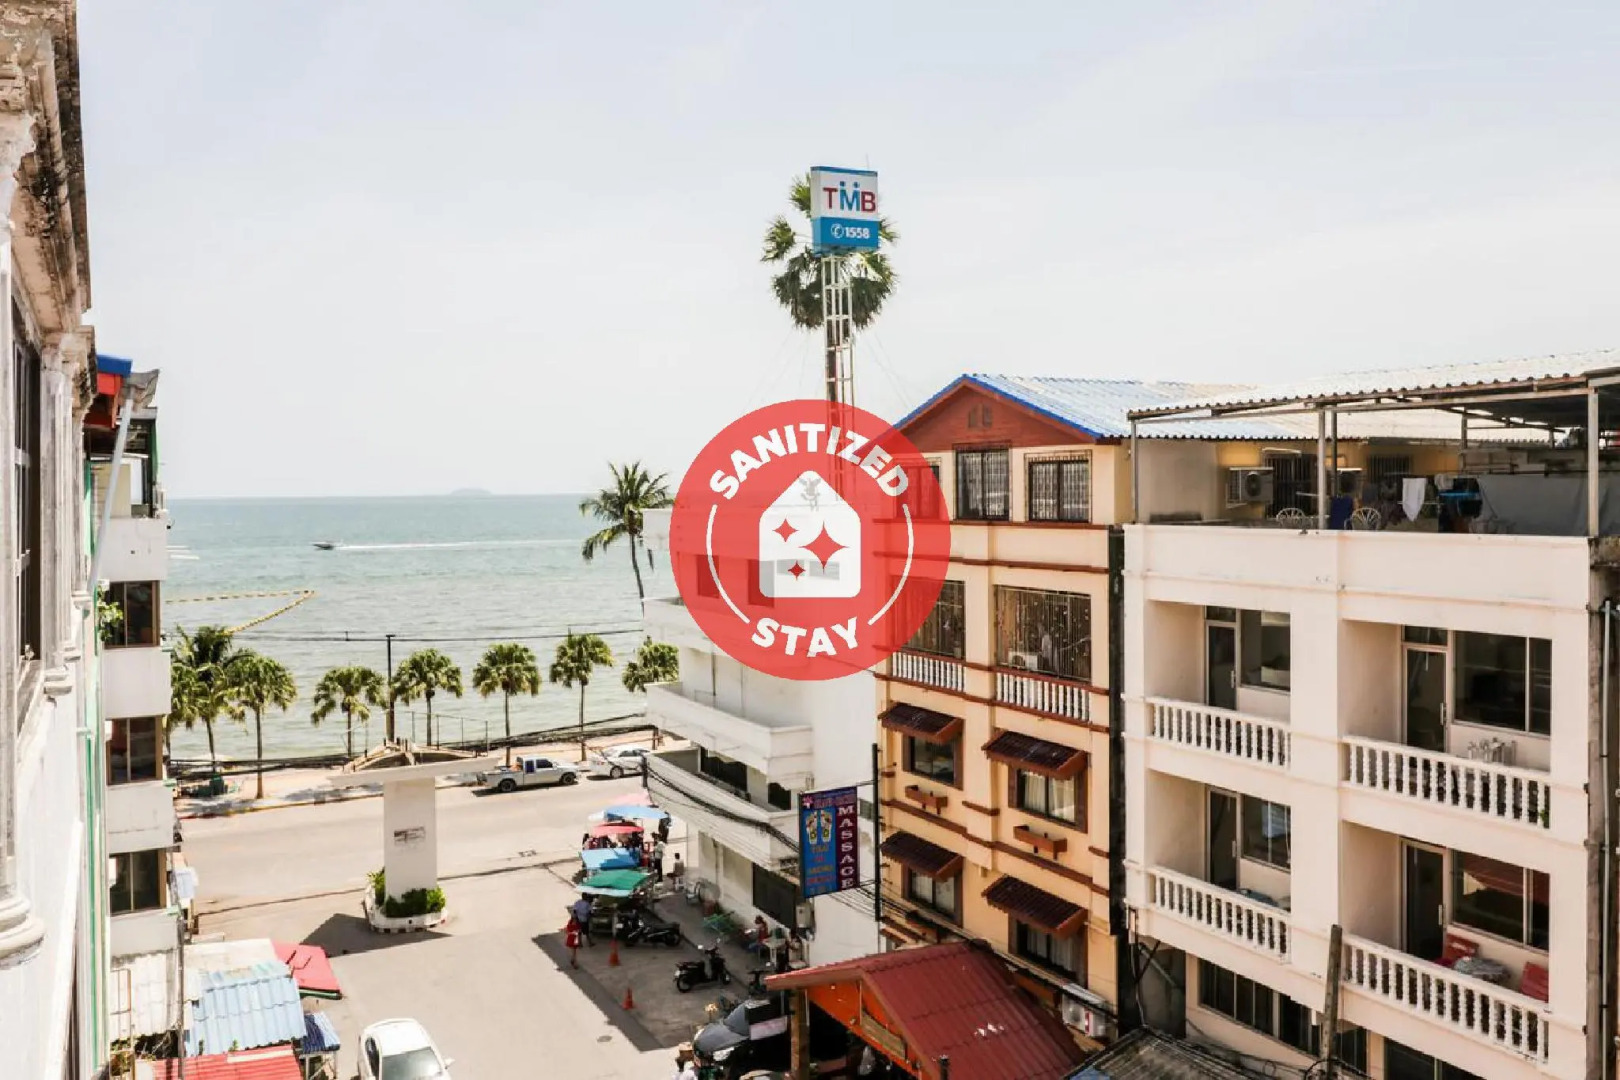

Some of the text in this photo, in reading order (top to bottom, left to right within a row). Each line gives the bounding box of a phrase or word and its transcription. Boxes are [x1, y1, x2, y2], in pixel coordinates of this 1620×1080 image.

[823, 181, 876, 212] TMB
[845, 226, 870, 239] 1558
[838, 805, 854, 889] MASSAGE
